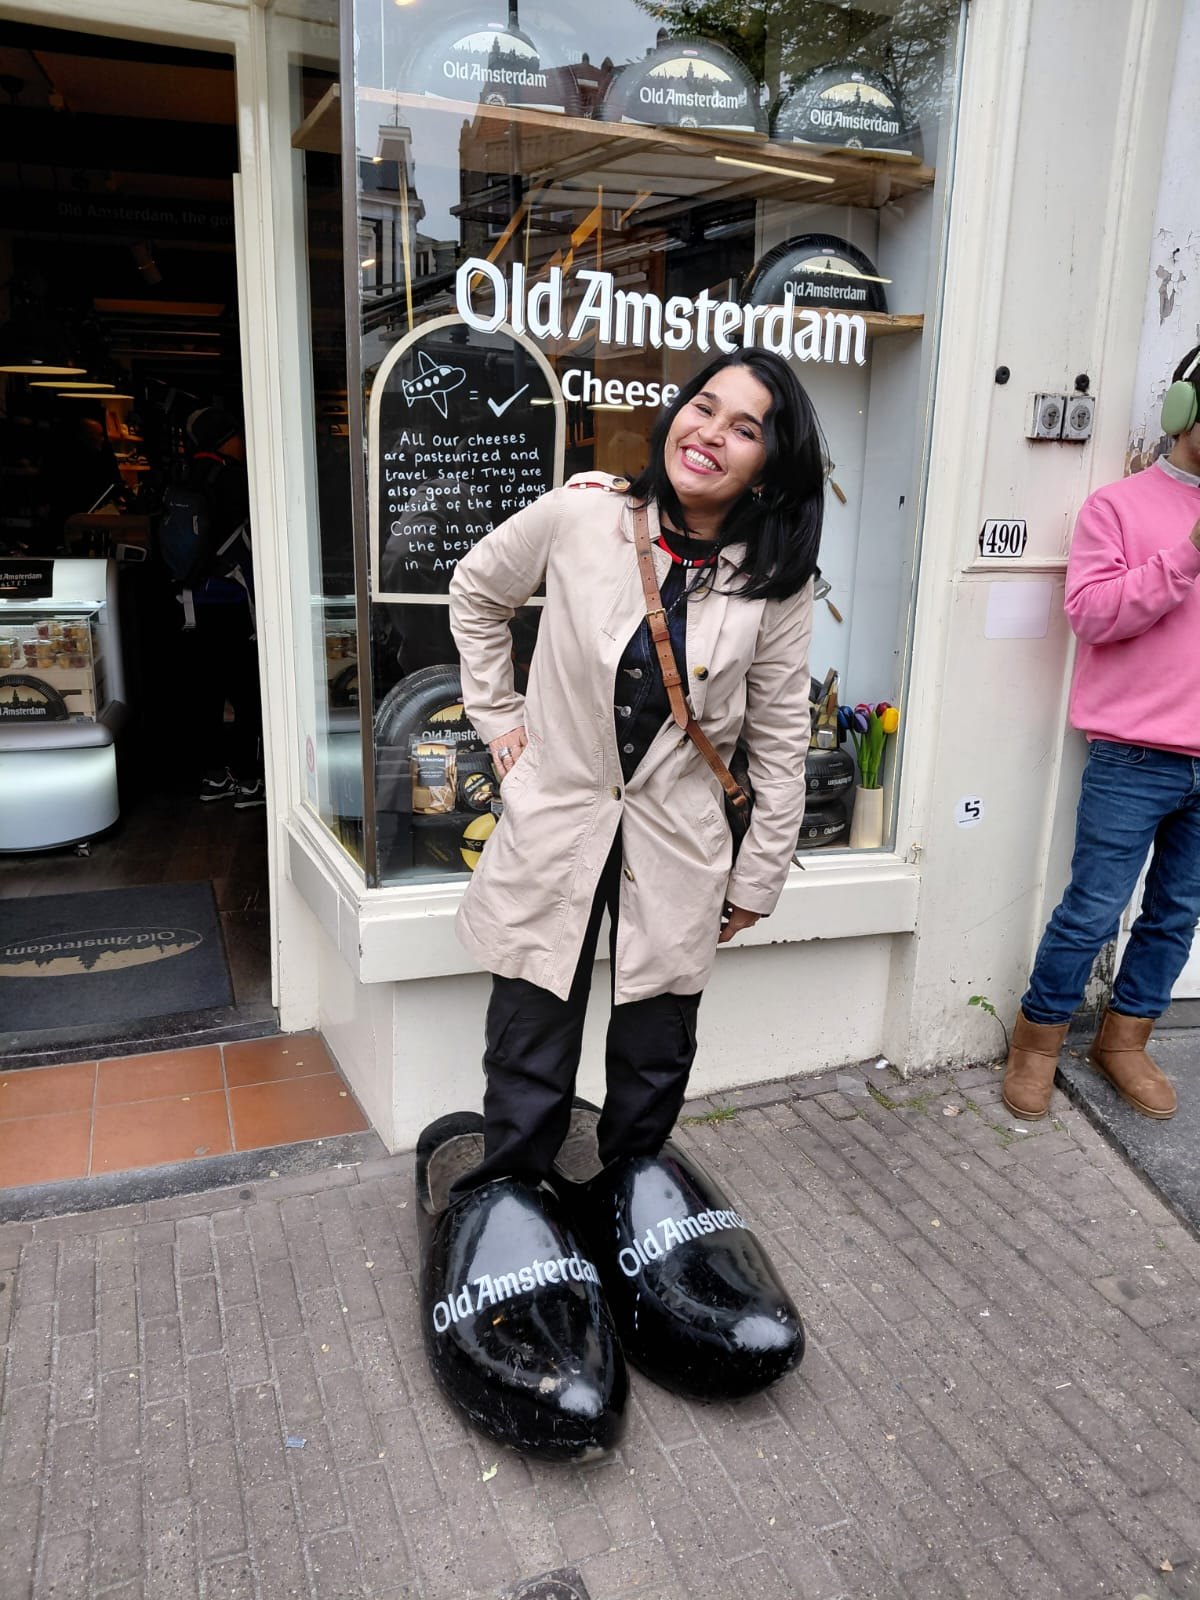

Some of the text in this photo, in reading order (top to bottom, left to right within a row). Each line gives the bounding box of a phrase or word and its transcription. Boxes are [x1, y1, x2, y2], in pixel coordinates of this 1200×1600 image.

[443, 60, 547, 88] Old Amsterdam
[640, 86, 738, 109] Old Amsterdam
[810, 109, 899, 134] Old Amsterdam
[784, 281, 866, 301] Old Amsterdam
[456, 257, 867, 367] Old Amsterdam
[562, 370, 680, 408] Cheese
[400, 431, 425, 446] All
[468, 433, 526, 446] cheeses
[384, 448, 540, 467] are pasteurized and
[386, 469, 427, 482] travel
[481, 467, 516, 482] They
[521, 469, 542, 477] are
[388, 483, 546, 500] also good for 10 days
[389, 501, 438, 513] outside
[446, 501, 461, 511] of
[468, 499, 493, 509] the
[391, 521, 494, 536] Come in and
[986, 524, 1020, 553] 490
[409, 541, 435, 552] the
[405, 557, 459, 571] in Am
[3, 706, 46, 716] Amsterdam
[6, 931, 175, 956] Old Amsterdam
[618, 1228, 664, 1277] Old
[433, 1285, 474, 1333] Old
